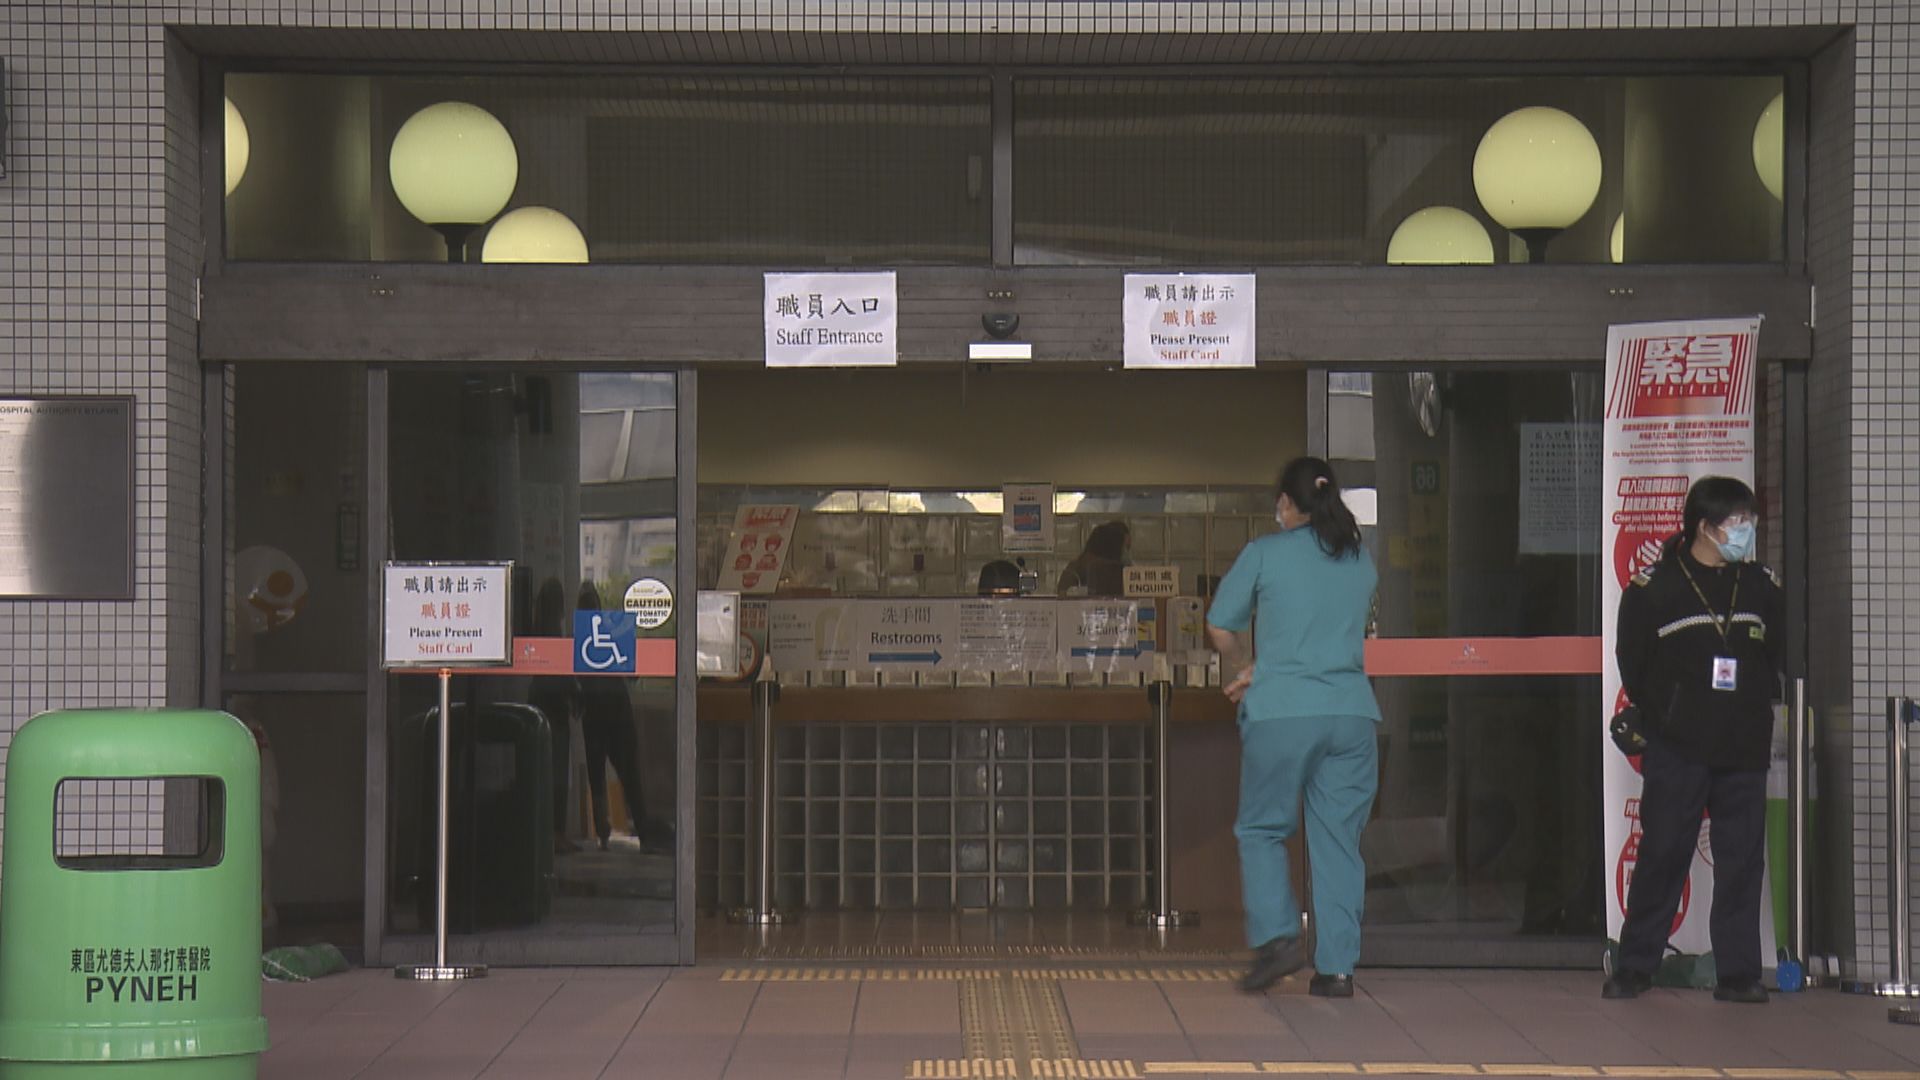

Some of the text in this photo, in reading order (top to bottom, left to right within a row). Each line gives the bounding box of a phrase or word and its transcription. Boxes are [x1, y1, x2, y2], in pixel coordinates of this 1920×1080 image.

[1144, 284, 1236, 302] 職員請出示
[776, 294, 880, 319] 職員入口
[1163, 310, 1218, 327] 職員證
[776, 328, 884, 345] Staff Entrance
[1150, 333, 1230, 346] Please Present
[1160, 349, 1220, 361] Staff Card
[1639, 336, 1734, 385] 緊急
[403, 576, 488, 593] 職員請出示
[1129, 583, 1173, 593] ENQUIRY
[420, 602, 472, 619] 職員證
[626, 598, 671, 608] CAUTION
[881, 606, 931, 624] 洗手間
[409, 626, 483, 639] Please Present
[871, 631, 943, 645] Restrooms
[418, 642, 474, 655] Staff Card
[70, 946, 211, 973] 東區尤德夫人那打素醫院
[86, 974, 197, 1003] PYNEH
